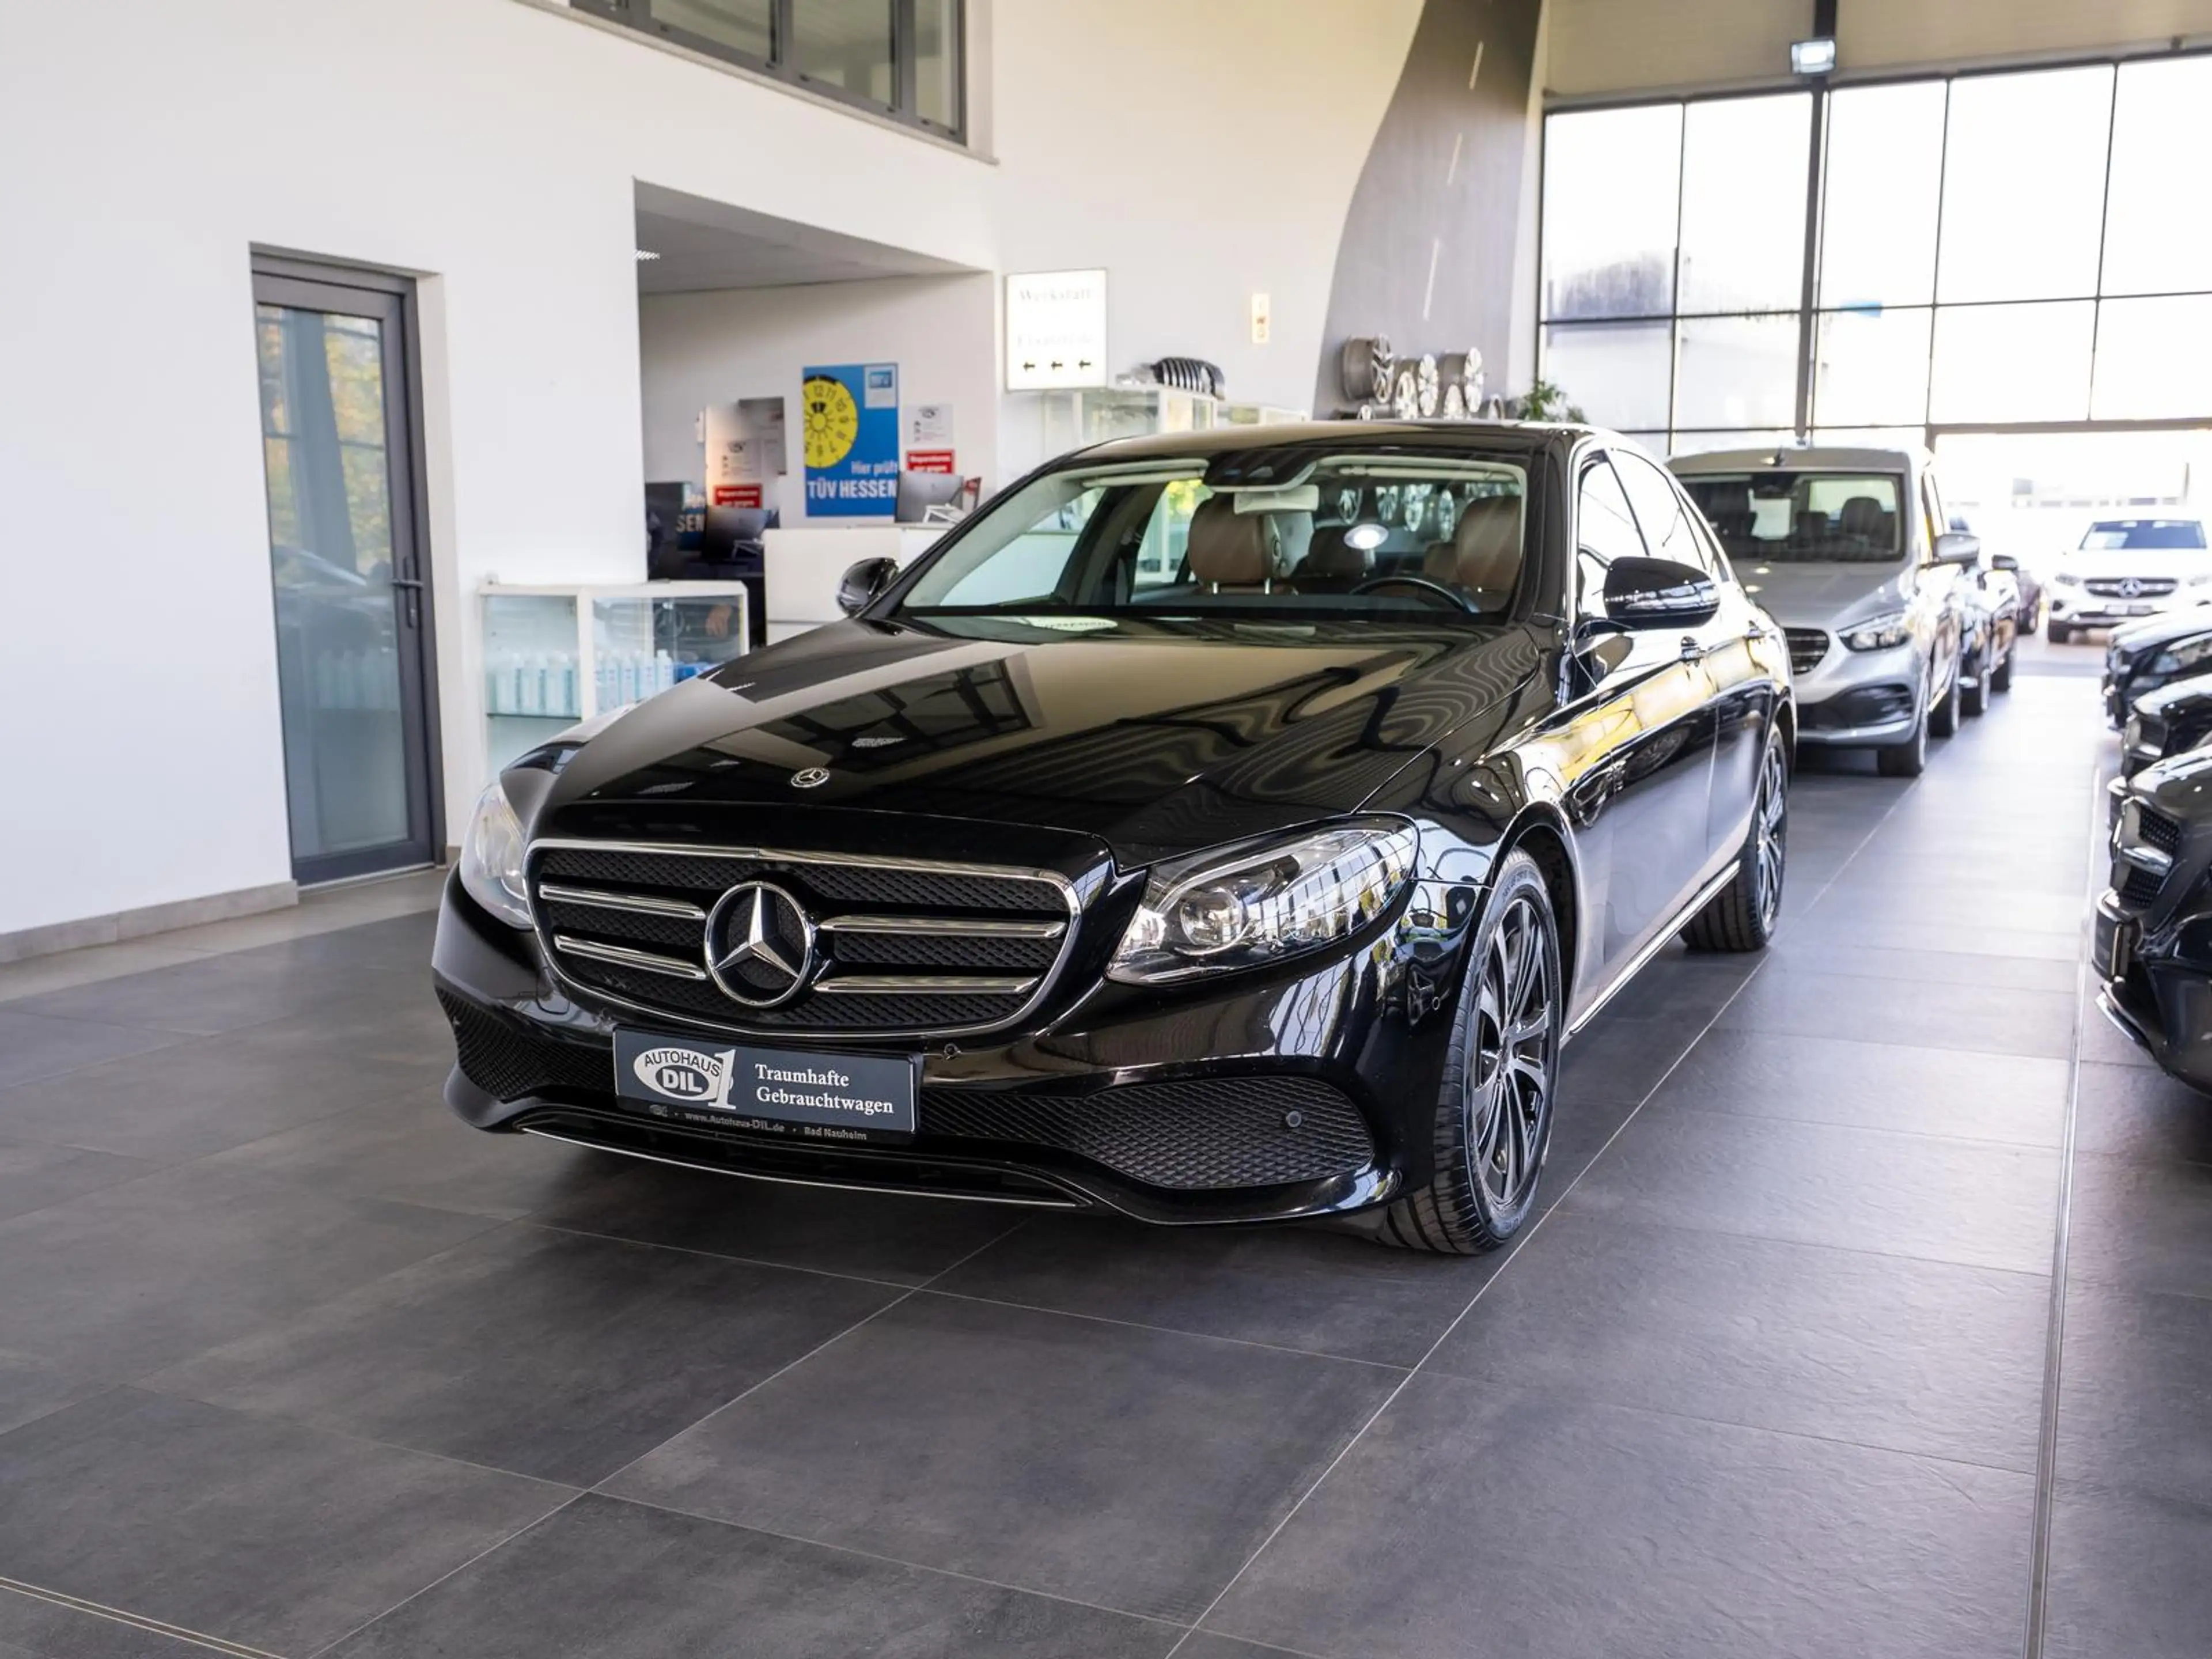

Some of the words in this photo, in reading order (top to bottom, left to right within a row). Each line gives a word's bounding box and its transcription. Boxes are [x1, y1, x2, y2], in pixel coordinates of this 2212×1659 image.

[851, 461, 871, 474] Hier
[808, 477, 837, 499] TÜV
[839, 479, 897, 498] HESSEN
[645, 1051, 720, 1077] AUTOHAUS
[755, 1063, 850, 1087] Traumhafte
[662, 1069, 703, 1093] DIL
[756, 1086, 895, 1115] Gebrauchtwagen
[804, 1126, 823, 1137] Bad
[824, 1128, 867, 1140] Nauheim
